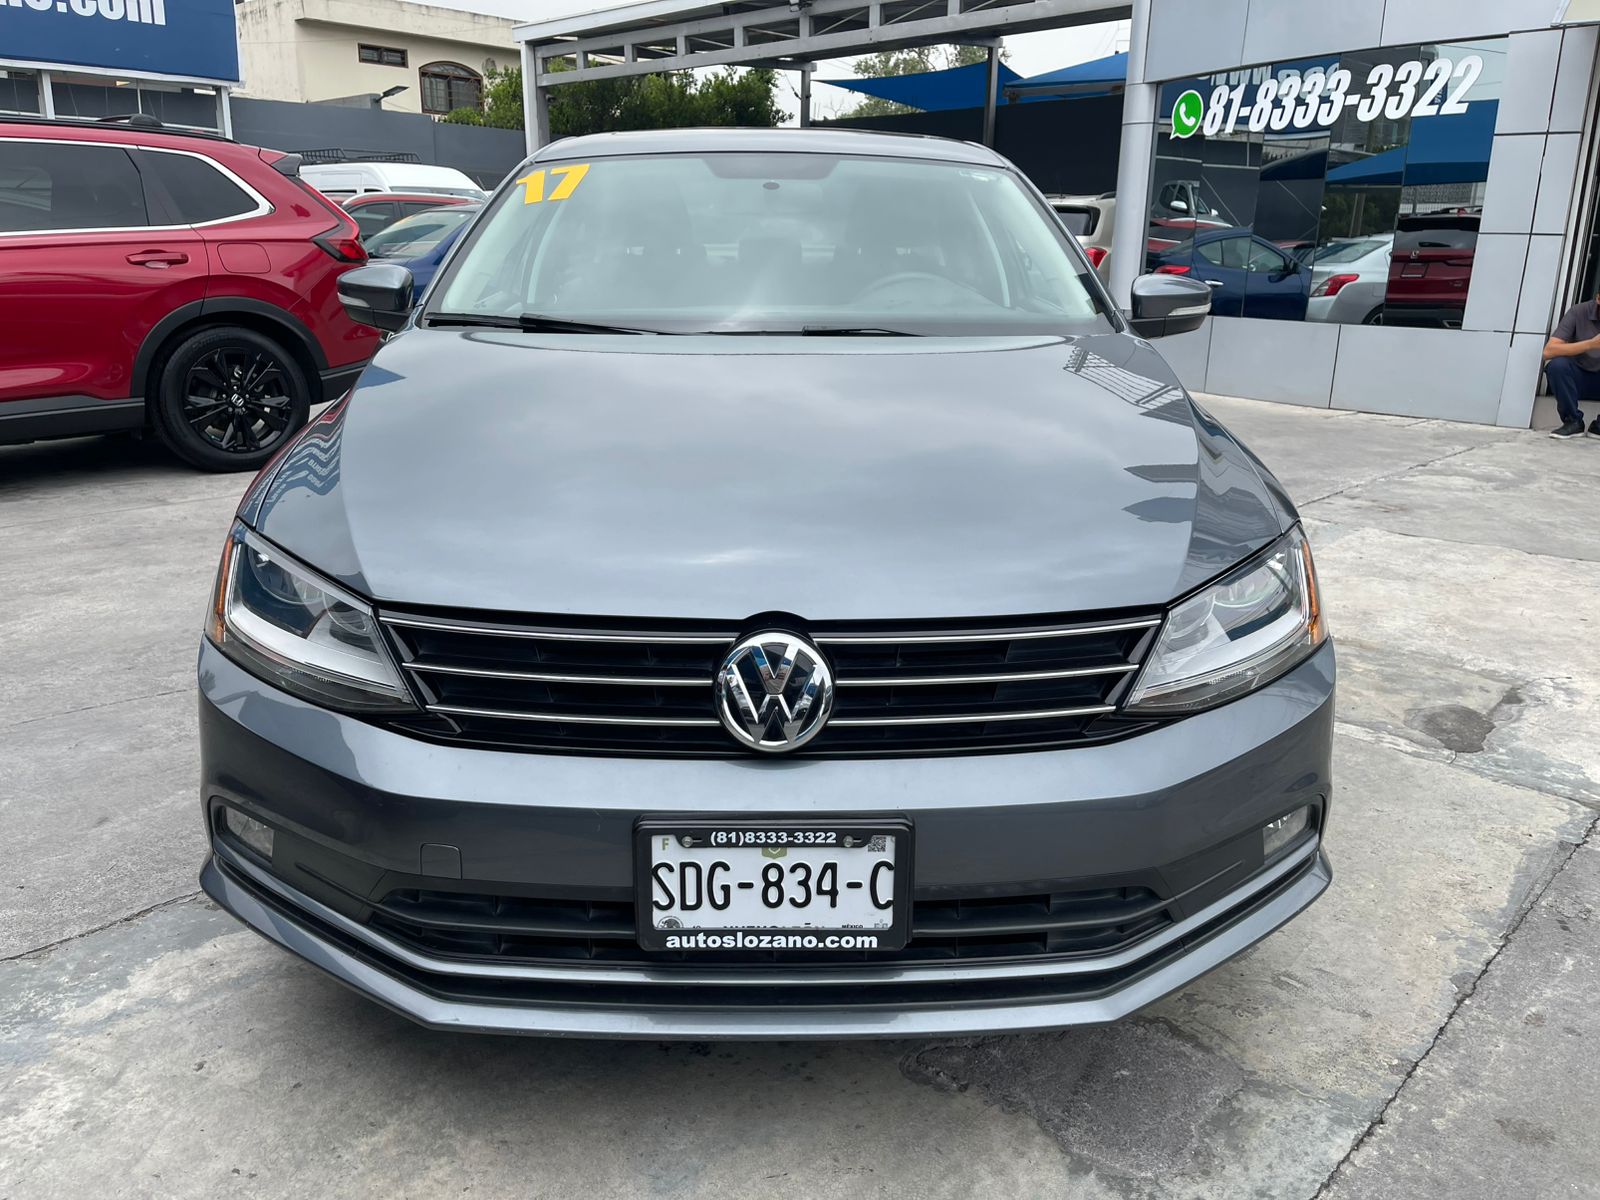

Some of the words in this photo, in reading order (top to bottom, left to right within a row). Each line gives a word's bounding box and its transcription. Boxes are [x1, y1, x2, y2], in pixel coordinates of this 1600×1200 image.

[1203, 55, 1483, 136] 81-8333-3322
[516, 163, 591, 205] 17
[718, 631, 833, 753] VW
[710, 831, 837, 846] (81)8333-3322
[651, 860, 895, 911] SDG-834-C
[665, 932, 878, 949] autoslozano.com
